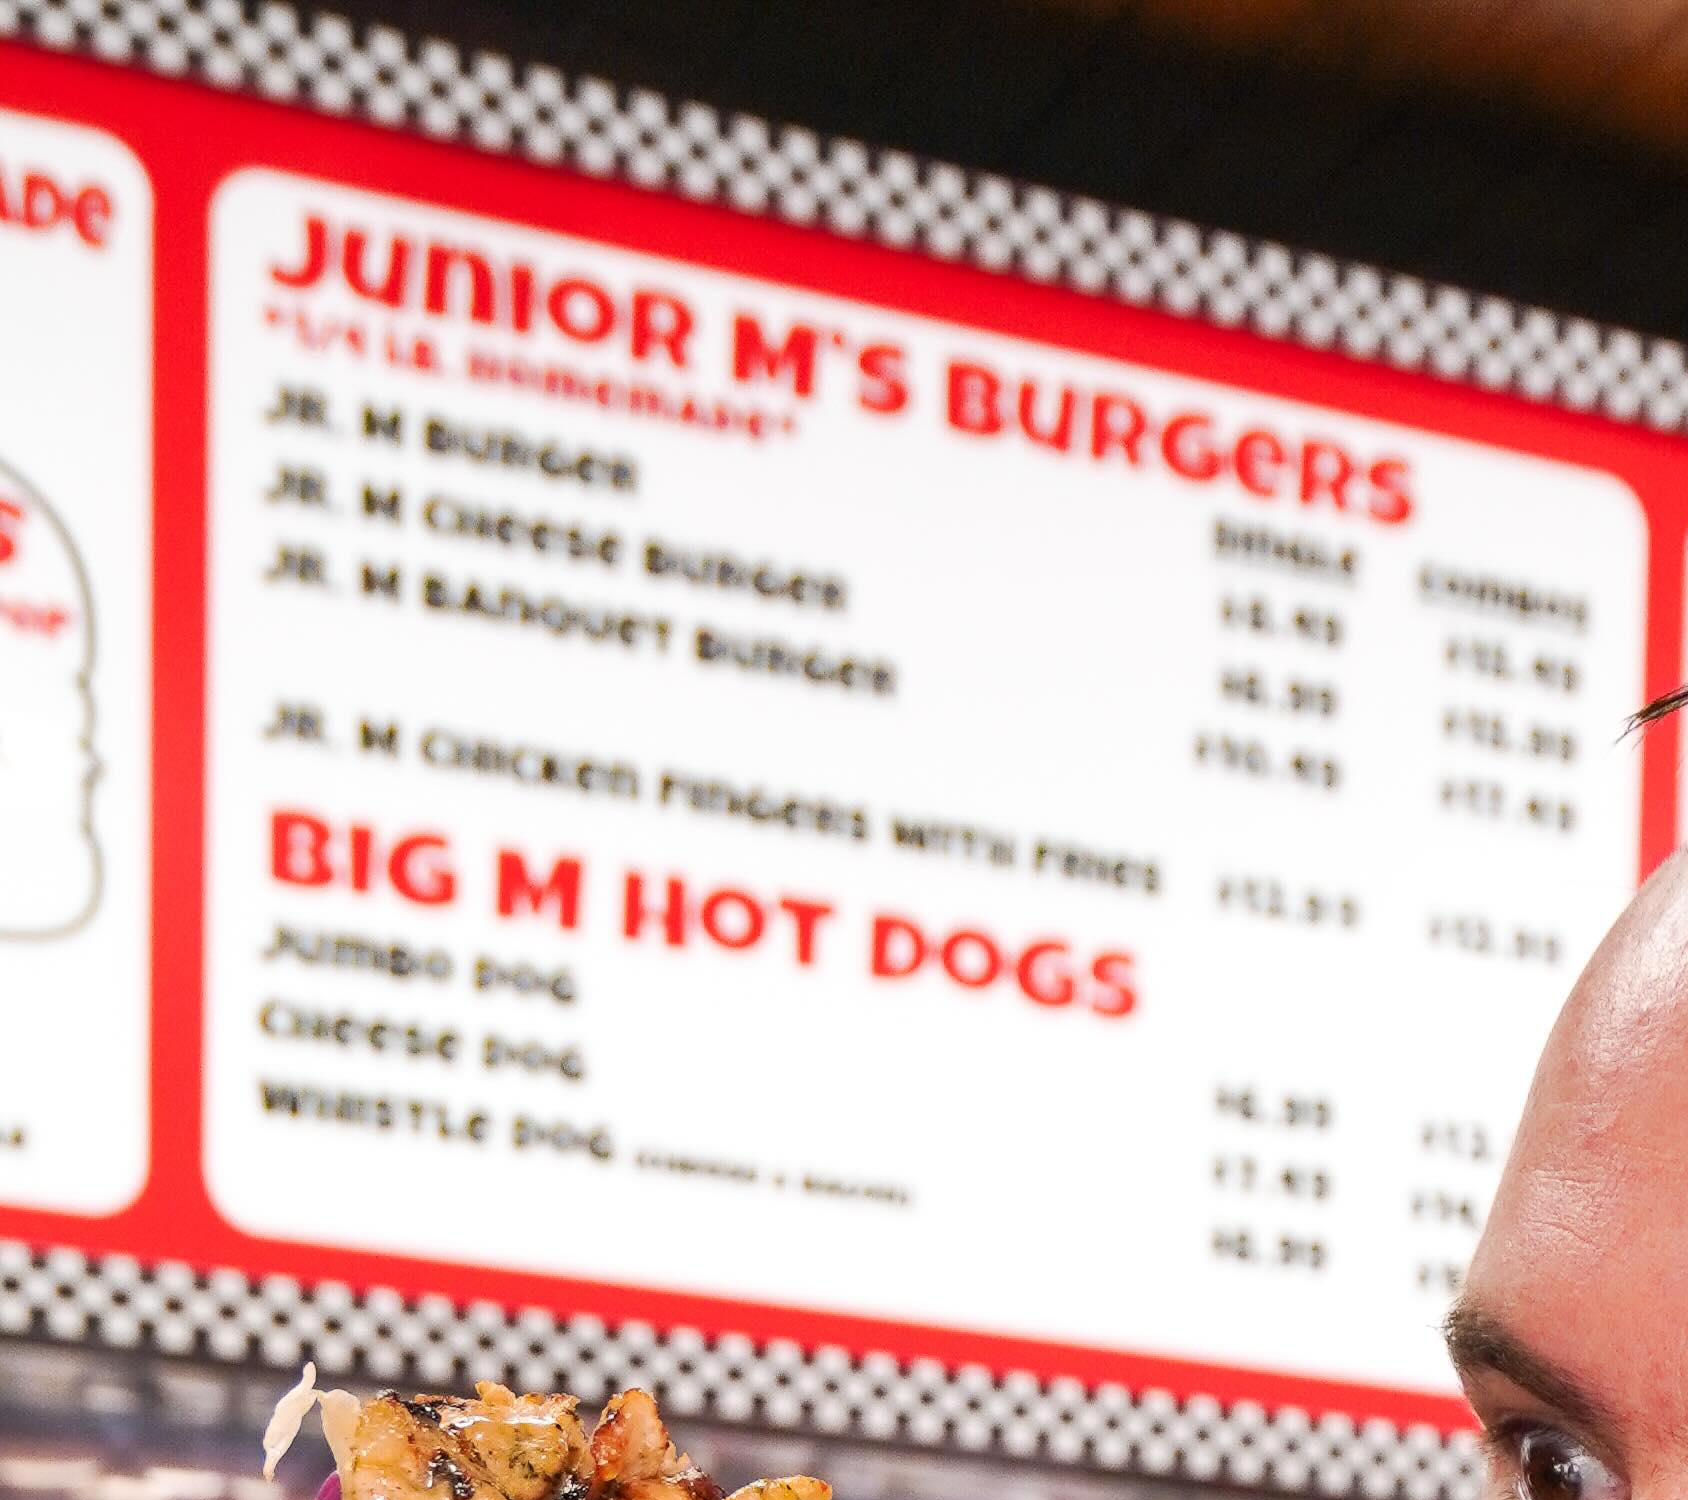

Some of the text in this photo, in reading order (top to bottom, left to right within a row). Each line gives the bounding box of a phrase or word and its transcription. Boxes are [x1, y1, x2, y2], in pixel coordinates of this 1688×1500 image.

[269, 211, 1416, 527] JUNIOR M'S BURGERS
[361, 406, 402, 447] M
[425, 417, 639, 492] BURGER
[361, 487, 402, 527] M
[361, 565, 402, 606] M
[270, 810, 1138, 1019] BIG M HOT DOGS
[475, 956, 578, 1003] DOG
[484, 1033, 585, 1082] DOG
[513, 1114, 613, 1162] DOG
